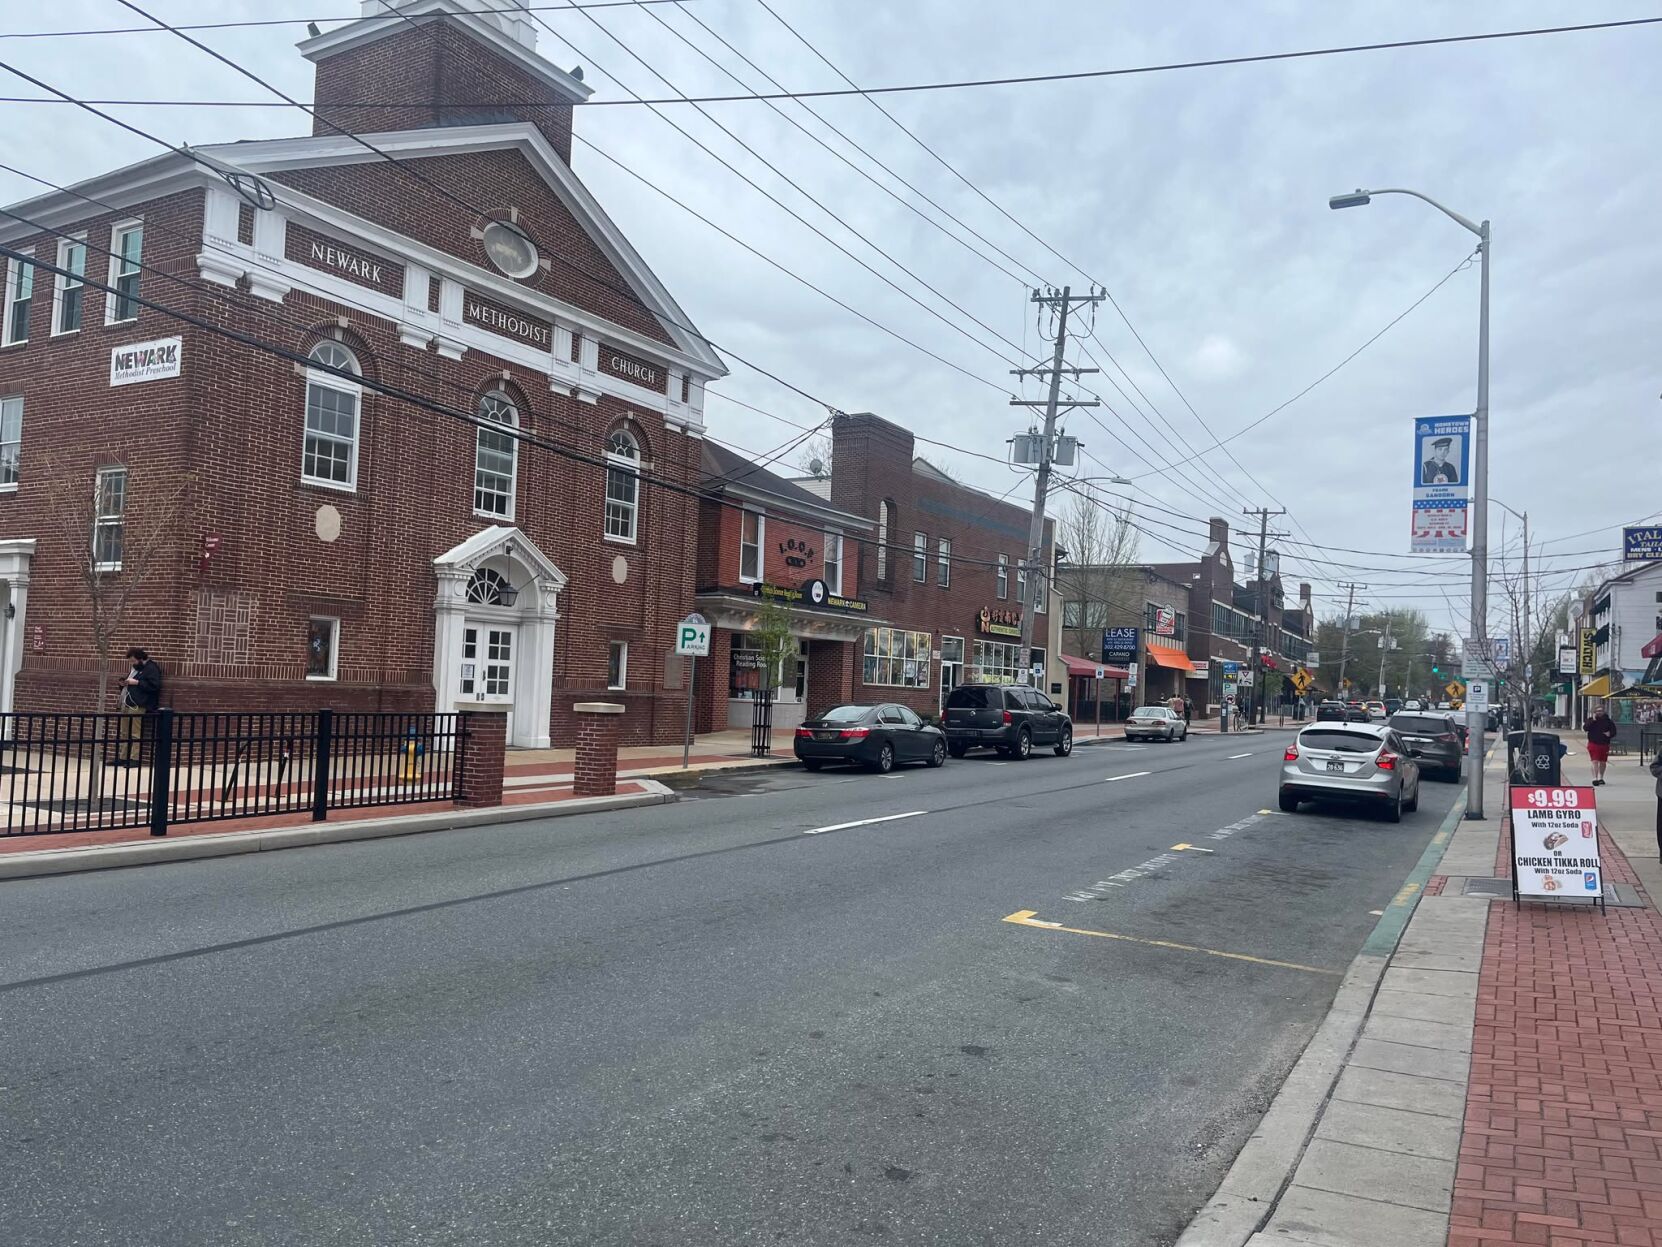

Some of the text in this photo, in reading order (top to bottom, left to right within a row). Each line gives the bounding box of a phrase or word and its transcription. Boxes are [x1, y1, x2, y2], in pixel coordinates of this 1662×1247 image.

[312, 242, 381, 283] NEWARK
[470, 303, 548, 343] METHODIST
[115, 345, 177, 371] NEWARK
[612, 357, 655, 383] CHURCH
[1434, 426, 1469, 434] HEROES
[828, 597, 867, 610] NEWARK CAMERA
[1105, 628, 1136, 638] LEASE
[736, 660, 756, 669] Reading
[1528, 789, 1578, 807] $9.99
[1528, 810, 1581, 819] LAMB GYRO
[1517, 857, 1599, 868] CHICKEN TIKKA ROLL
